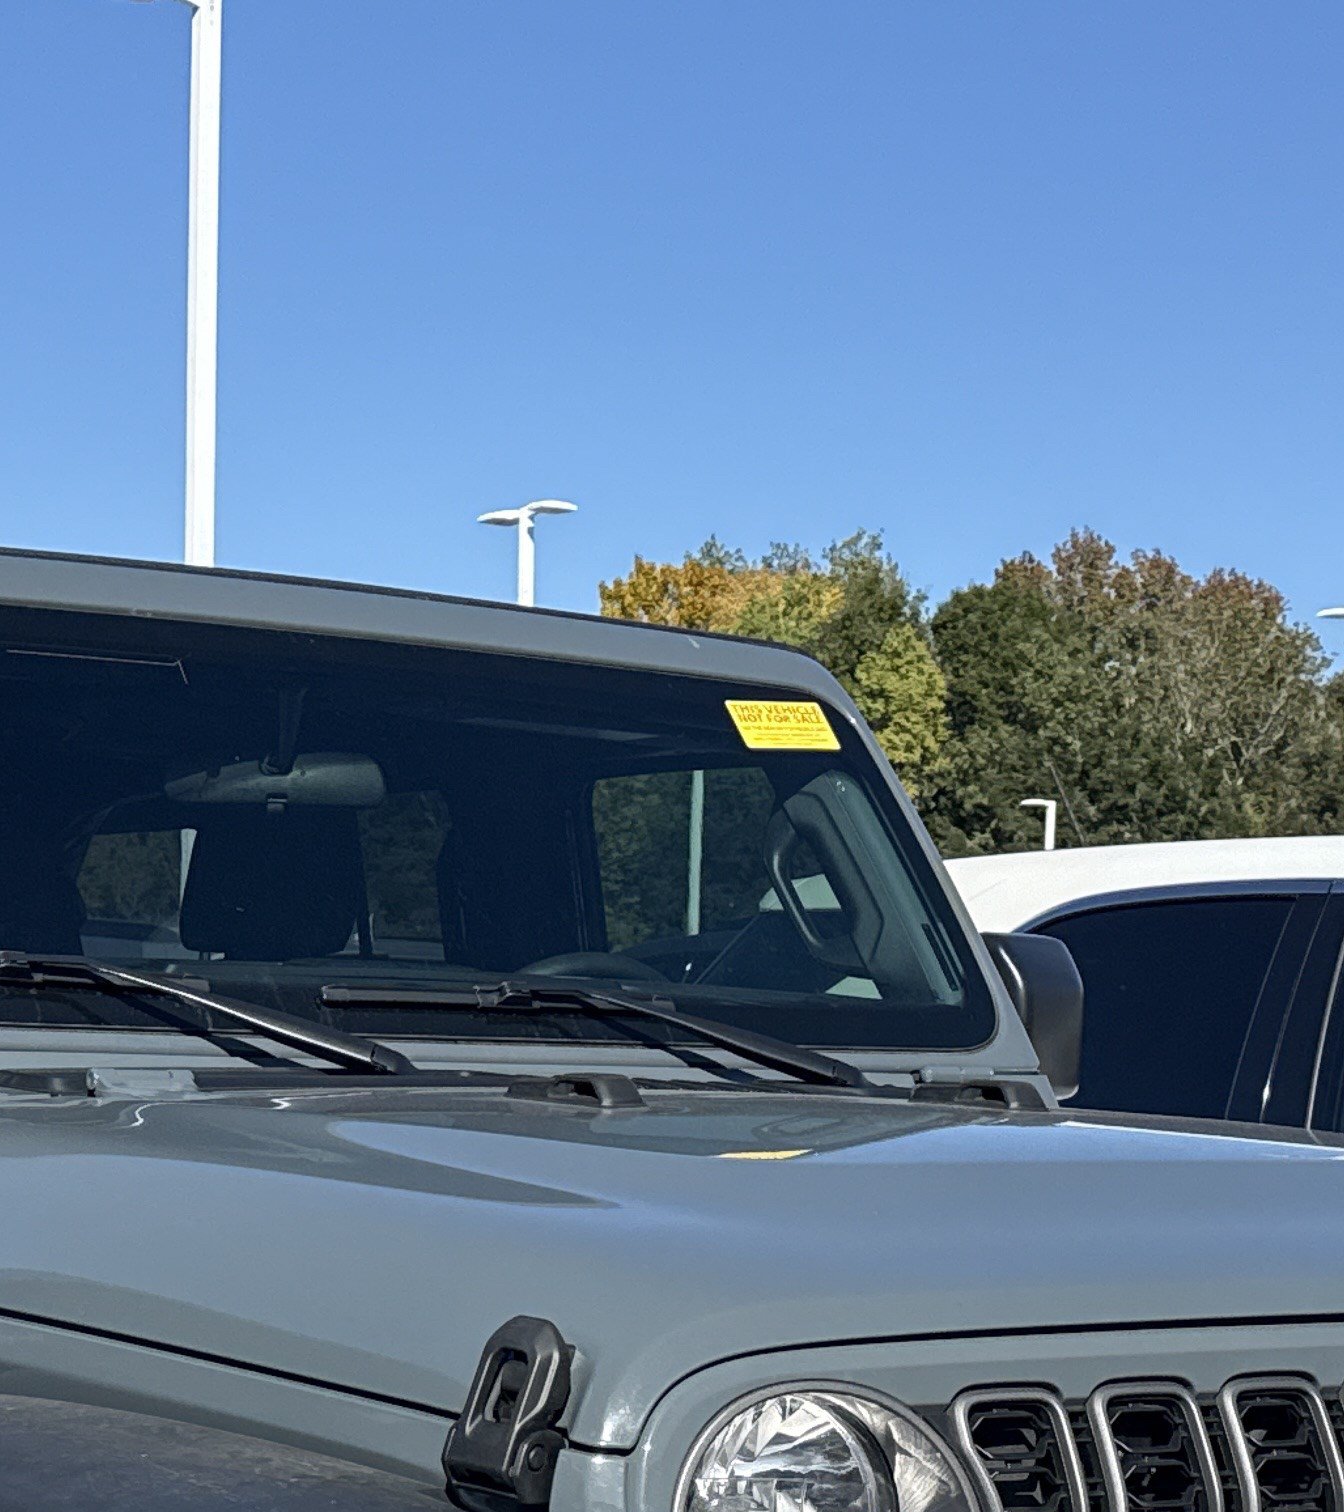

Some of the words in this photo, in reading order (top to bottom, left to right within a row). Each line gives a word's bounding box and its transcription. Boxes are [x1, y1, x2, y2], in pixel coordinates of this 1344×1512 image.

[730, 704, 762, 714] THIS
[762, 704, 820, 715] VEHICLE
[737, 713, 762, 723] NOT
[765, 714, 791, 723] FOR
[792, 713, 824, 724] SALE
